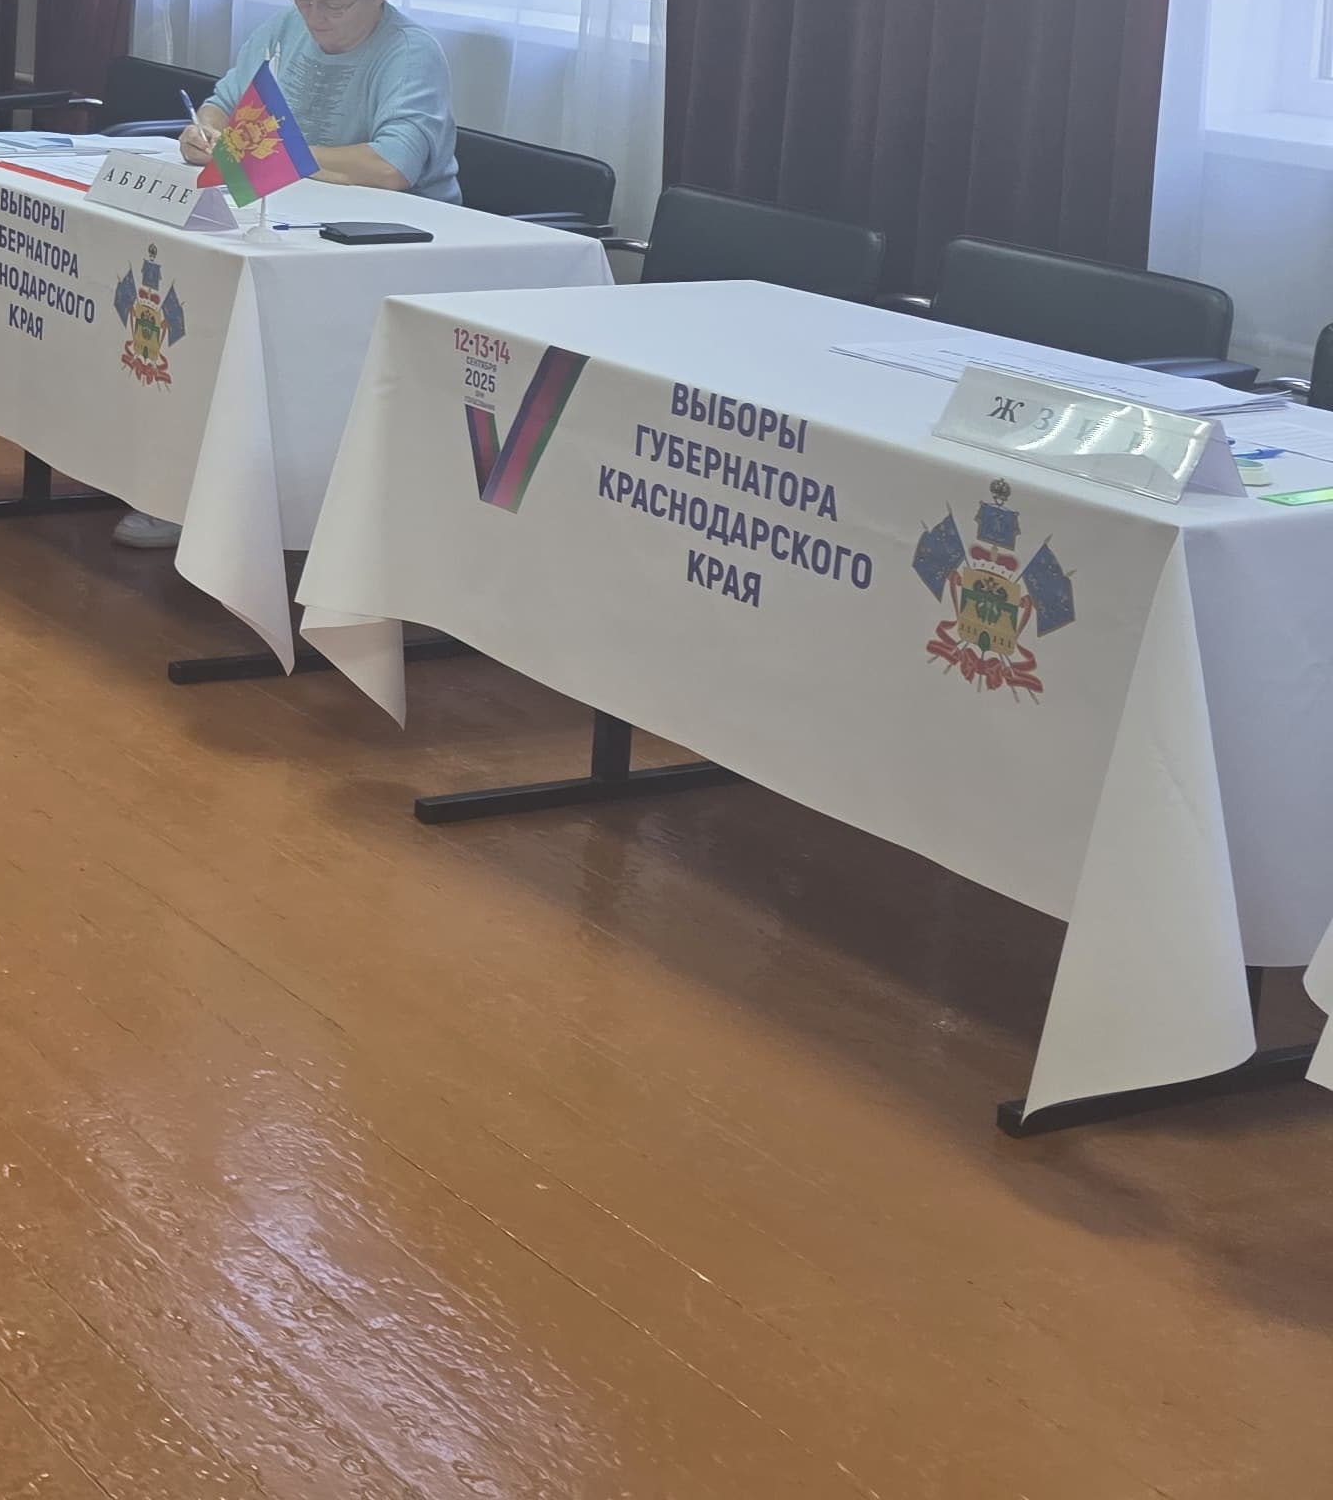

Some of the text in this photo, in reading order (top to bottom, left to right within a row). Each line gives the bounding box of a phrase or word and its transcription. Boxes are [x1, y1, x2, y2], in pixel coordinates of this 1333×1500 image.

[0, 187, 65, 233] ВЫБОРЫ
[9, 303, 43, 340] КРАЯ
[465, 368, 496, 393] 2025
[671, 382, 808, 454] ВЫБОРЫ
[635, 424, 838, 522] ГУБЕРНАТОРА
[598, 465, 873, 590] КРАСНОДАРСКОГО
[687, 549, 762, 608] КРАЯ
